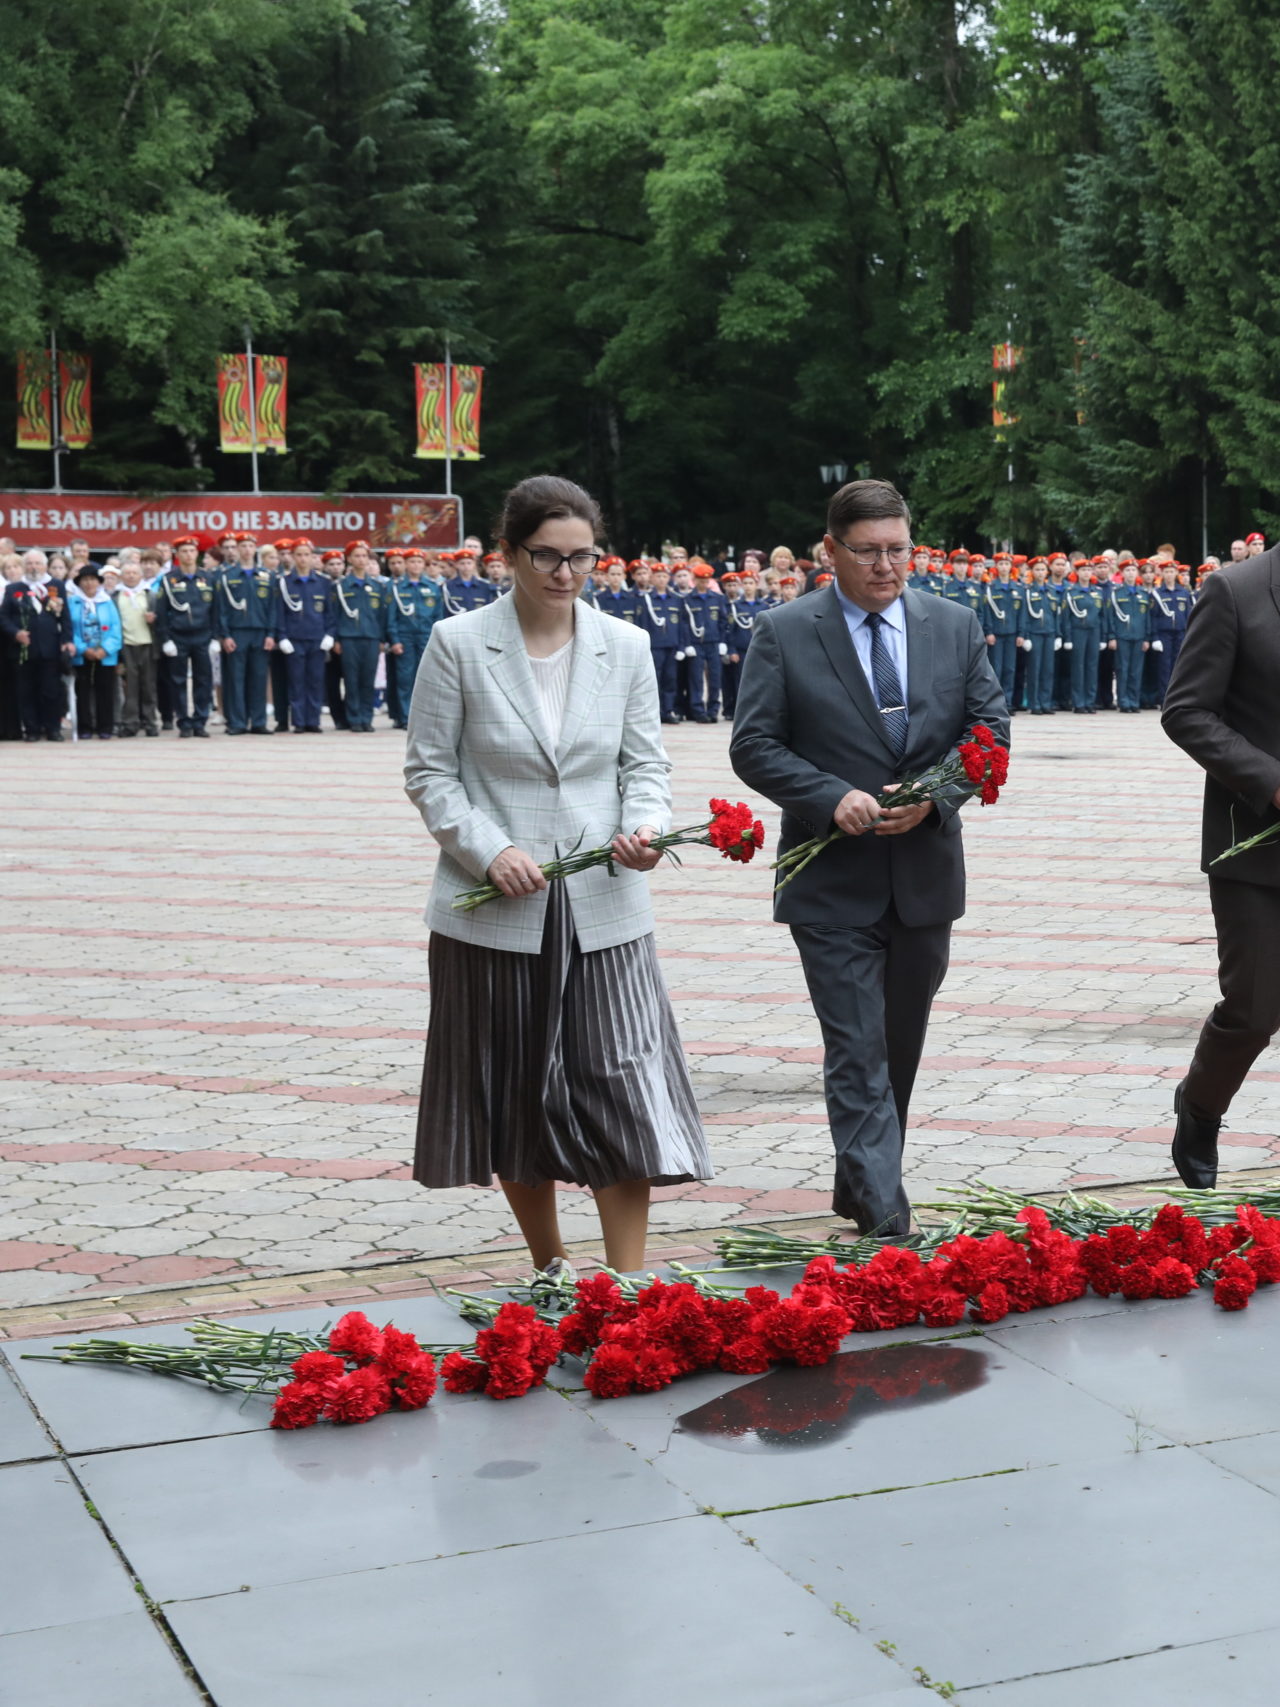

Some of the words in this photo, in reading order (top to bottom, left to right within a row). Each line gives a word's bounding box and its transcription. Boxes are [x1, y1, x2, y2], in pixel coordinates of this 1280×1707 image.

[11, 509, 42, 529] НЕ
[47, 509, 137, 533] ЗАБЫТ,
[143, 511, 227, 530] НИЧТО
[233, 511, 261, 530] НЕ
[267, 511, 363, 530] ЗАБЫТО
